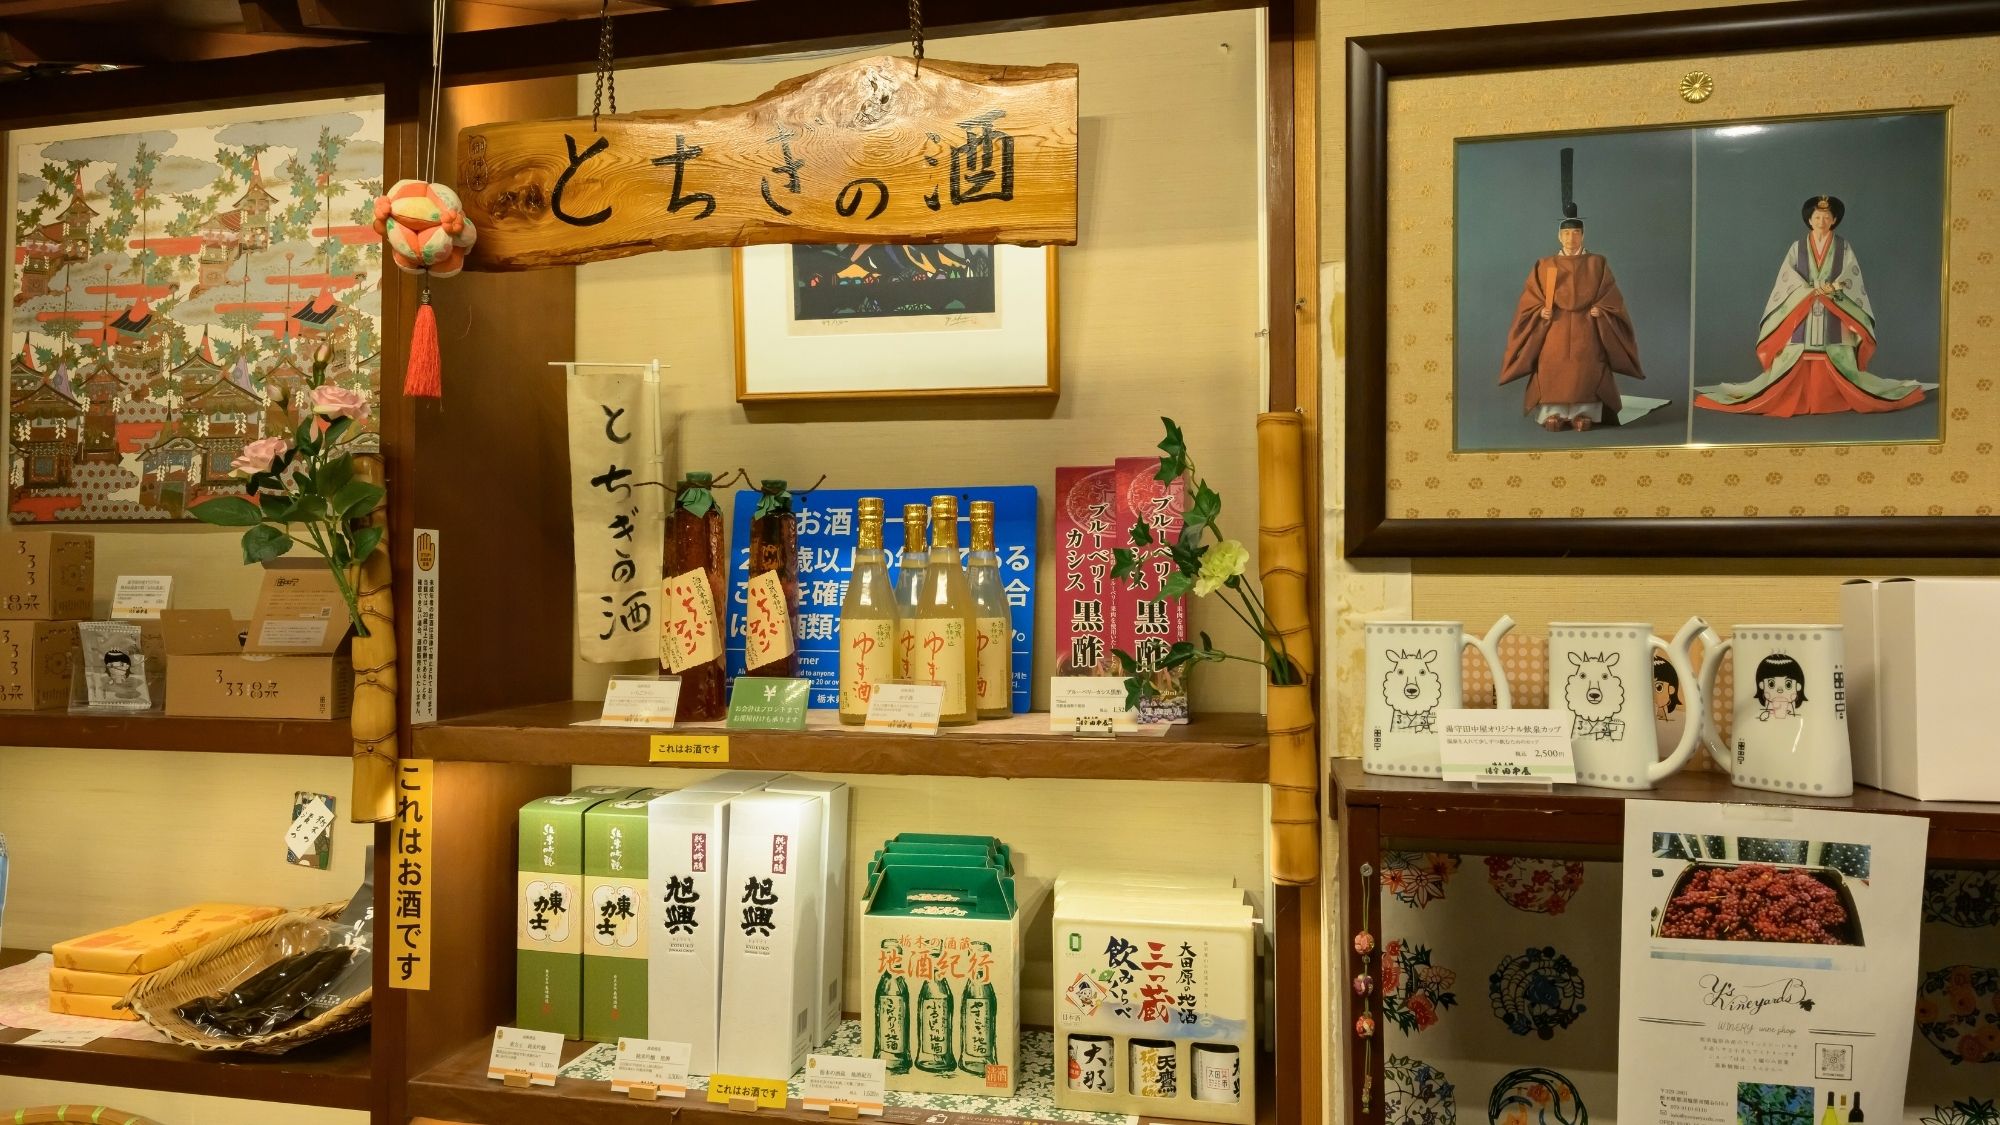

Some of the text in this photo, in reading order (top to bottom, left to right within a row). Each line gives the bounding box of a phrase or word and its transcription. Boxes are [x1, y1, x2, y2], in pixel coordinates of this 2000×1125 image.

[591, 404, 651, 640] とちぎの酒
[1066, 528, 1085, 592] カシス
[1087, 503, 1110, 595] ブルーベリー
[1071, 598, 1104, 668] 黒酢
[1134, 598, 1171, 673] 黒酢
[763, 685, 777, 702] ¥
[813, 671, 835, 679] anyone
[853, 631, 875, 703] ゆず酒
[658, 744, 720, 754] これはお酒です
[1446, 725, 1561, 734] 湯守田中屋オリジナル飲泉カップ
[1535, 749, 1565, 758] 2,500円
[396, 767, 424, 981] これはお酒です
[693, 834, 705, 871] 純米吟醸
[773, 836, 786, 873] 純米吟醸
[663, 875, 700, 935] 旭興
[740, 876, 779, 937] 旭興
[878, 949, 994, 983] 地酒紀行
[900, 934, 973, 951] 栃木の酒蔵
[1104, 936, 1143, 1019] 飲みくらべ
[1137, 942, 1175, 1024] 三つ蔵
[1176, 941, 1198, 1024] 大田原の地酒
[885, 998, 899, 1050] こだわりの地酒
[927, 1001, 945, 1054] ふるさとの地酒
[717, 1084, 779, 1099] これはお酒です
[1083, 1044, 1107, 1090] 大那
